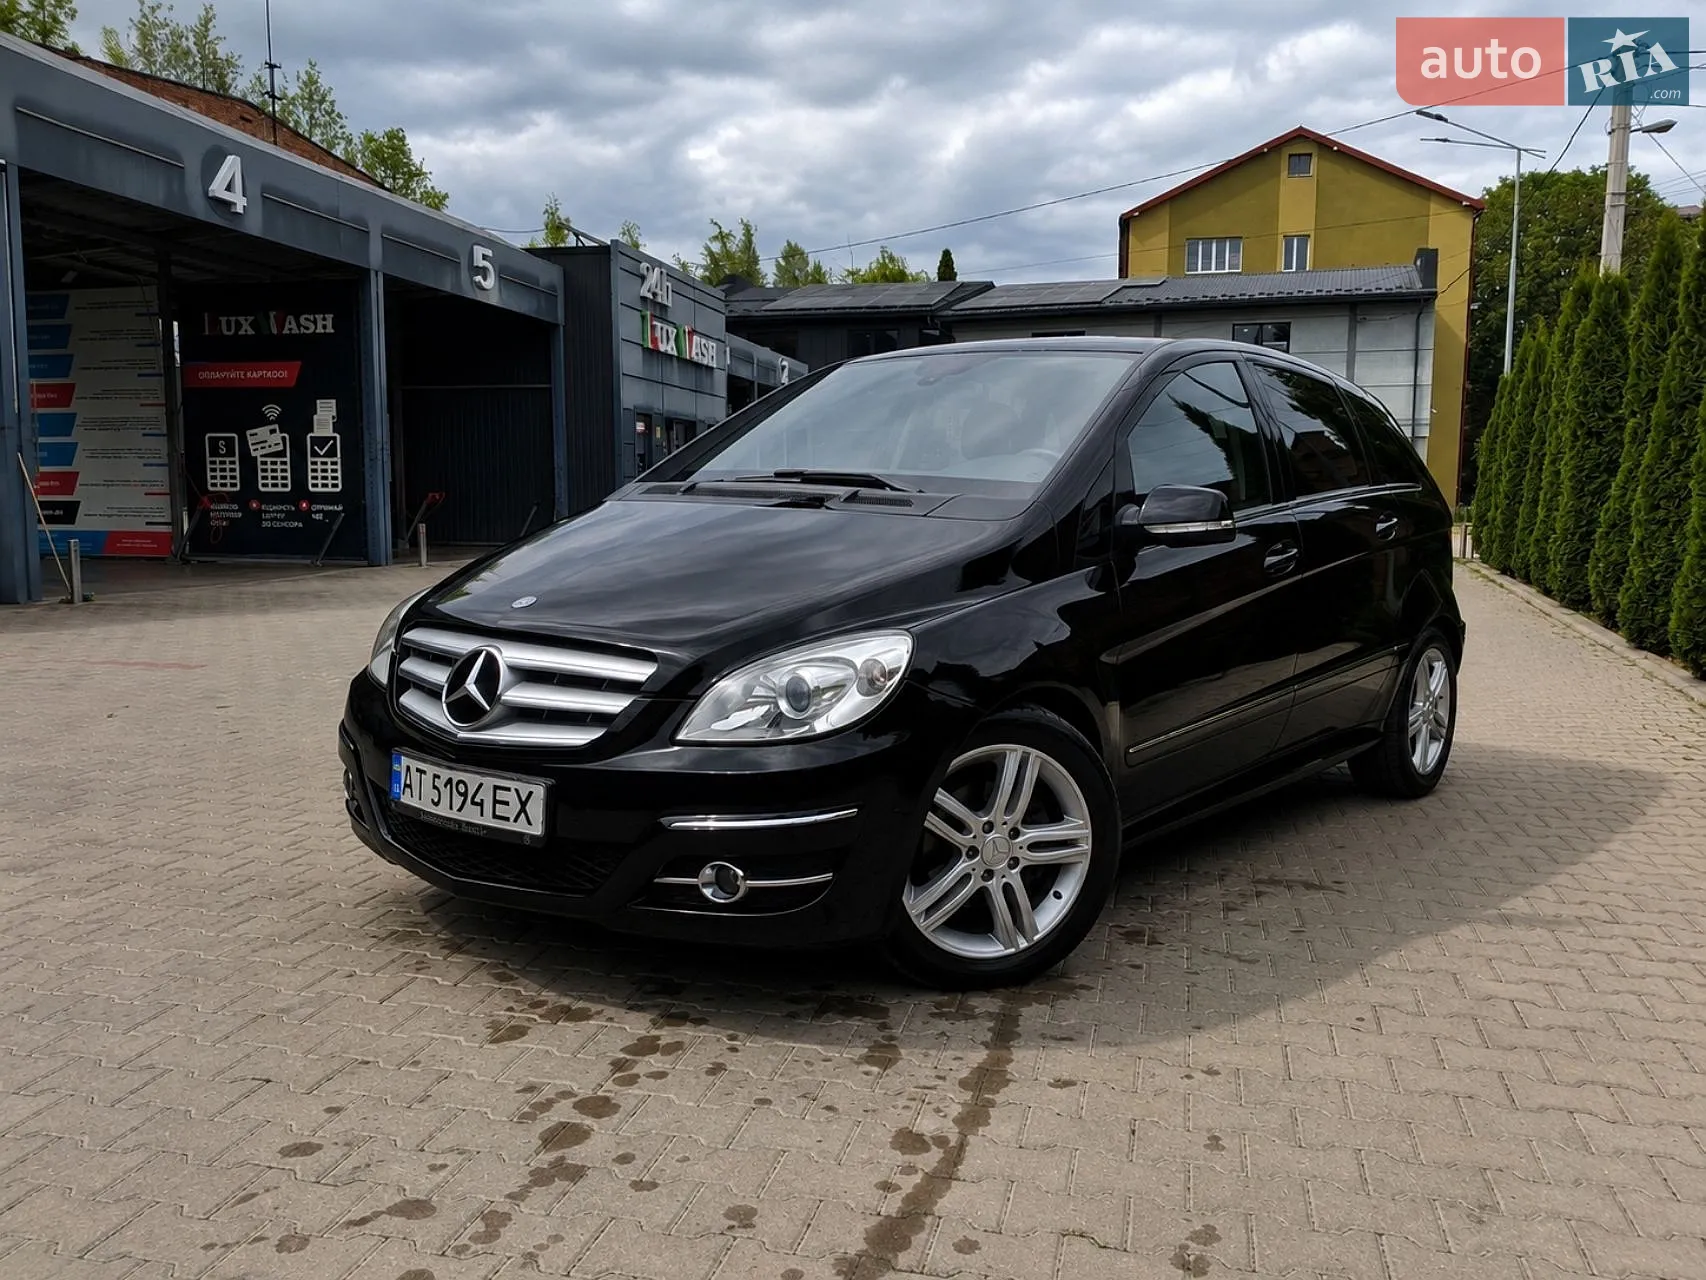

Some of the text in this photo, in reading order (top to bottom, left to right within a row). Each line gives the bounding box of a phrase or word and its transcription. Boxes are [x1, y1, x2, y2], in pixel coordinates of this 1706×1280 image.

[208, 154, 247, 214] 4
[472, 244, 496, 291] 5
[402, 764, 427, 801] AT
[431, 773, 485, 818] 5194
[492, 784, 534, 827] EX
